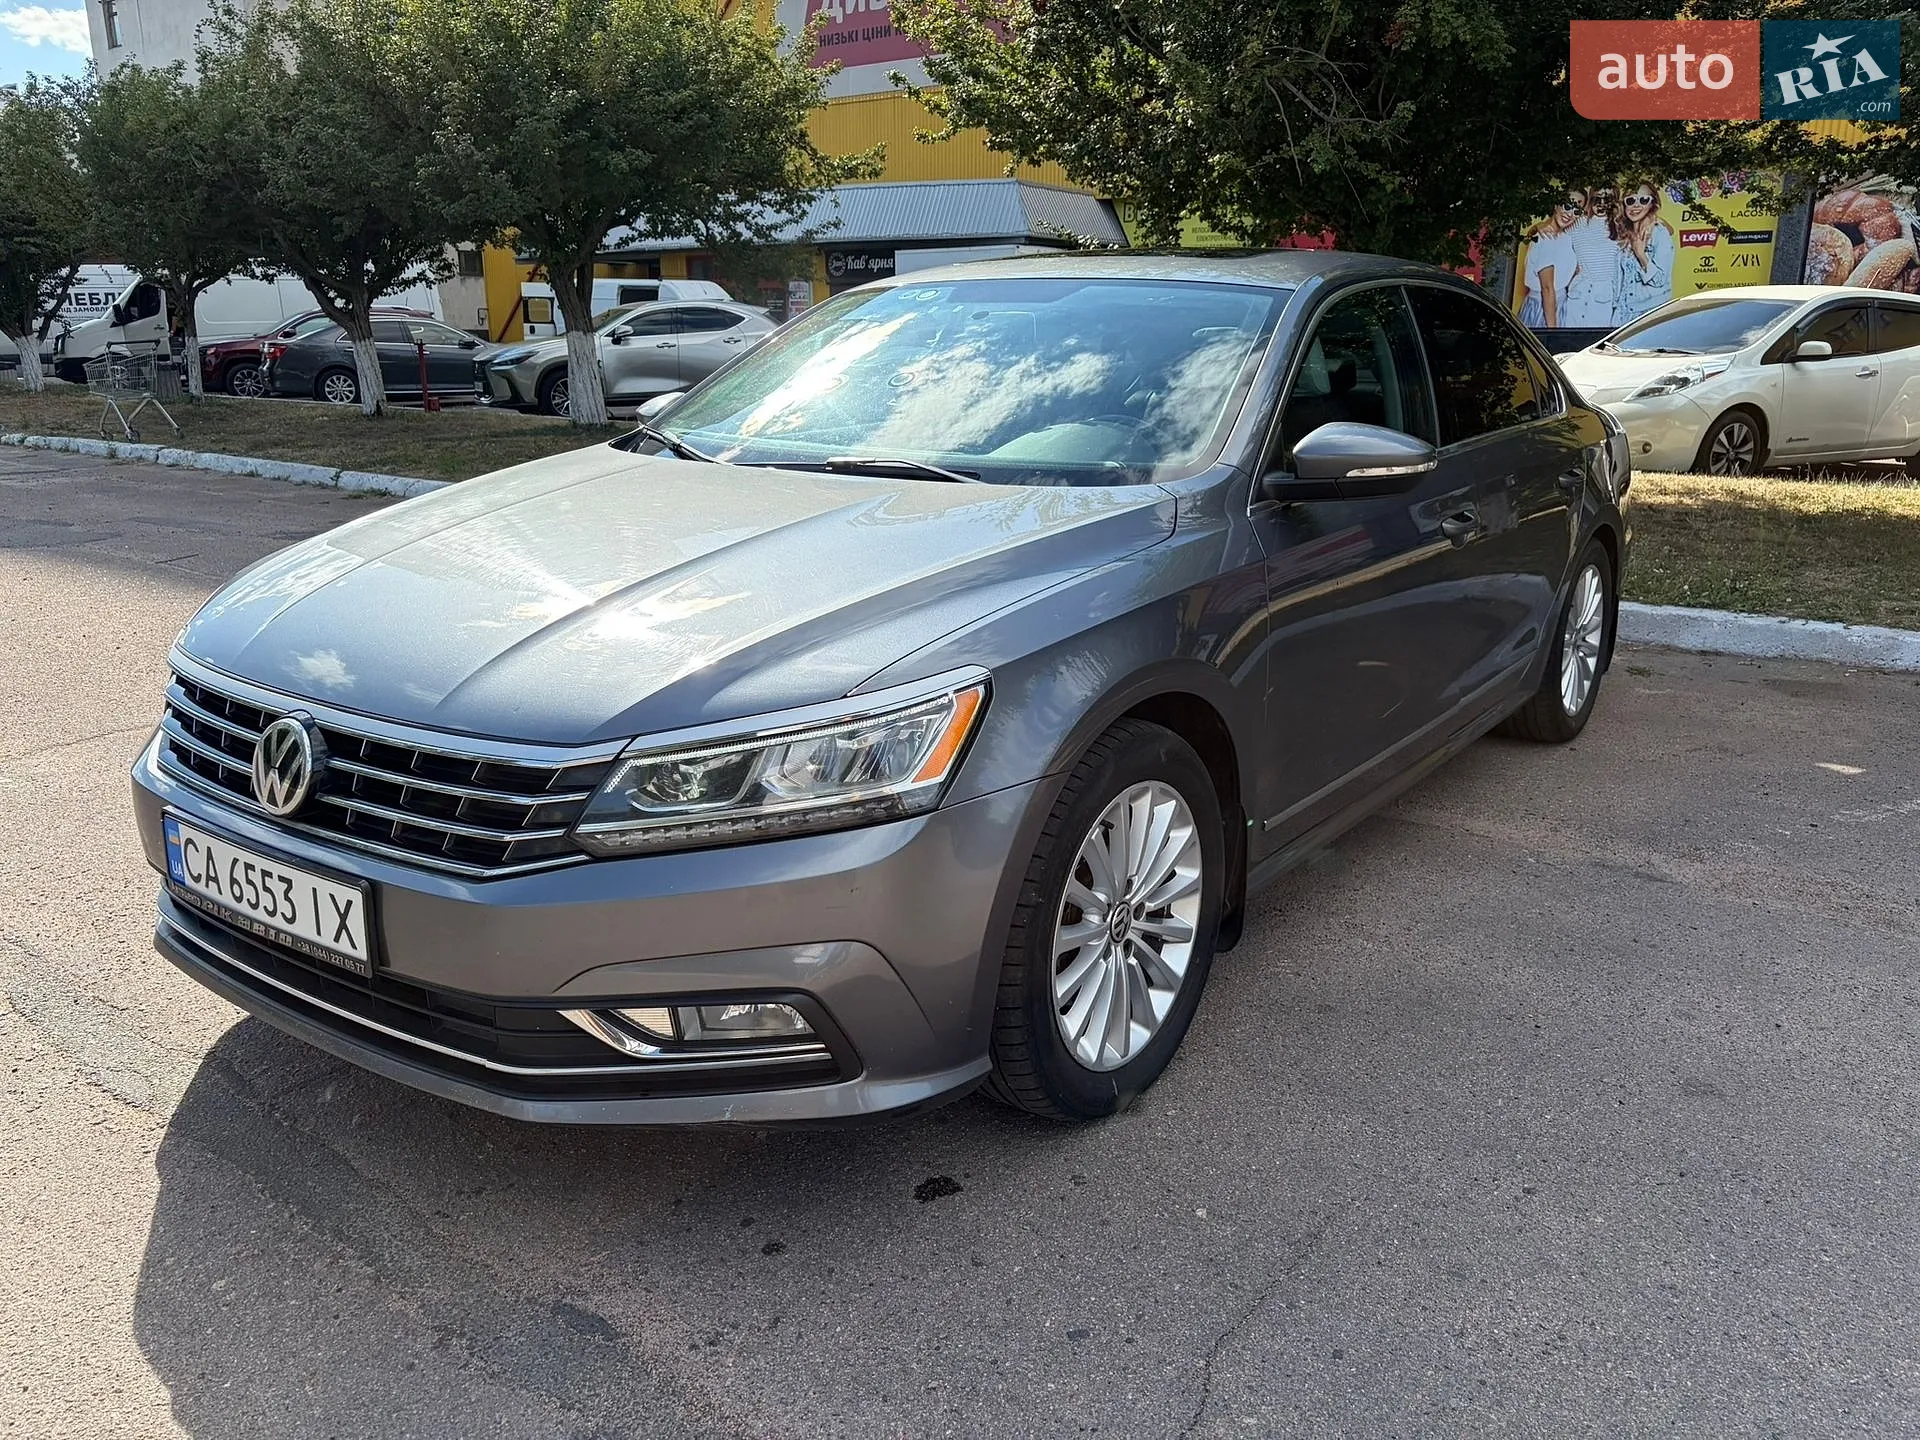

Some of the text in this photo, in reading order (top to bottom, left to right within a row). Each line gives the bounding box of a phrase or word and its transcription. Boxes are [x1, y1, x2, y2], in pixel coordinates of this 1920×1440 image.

[819, 29, 858, 47] НИЗЬКІ
[862, 25, 891, 43] ЦІНИ
[171, 860, 184, 877] UA
[183, 837, 358, 951] CA 6553 IX
